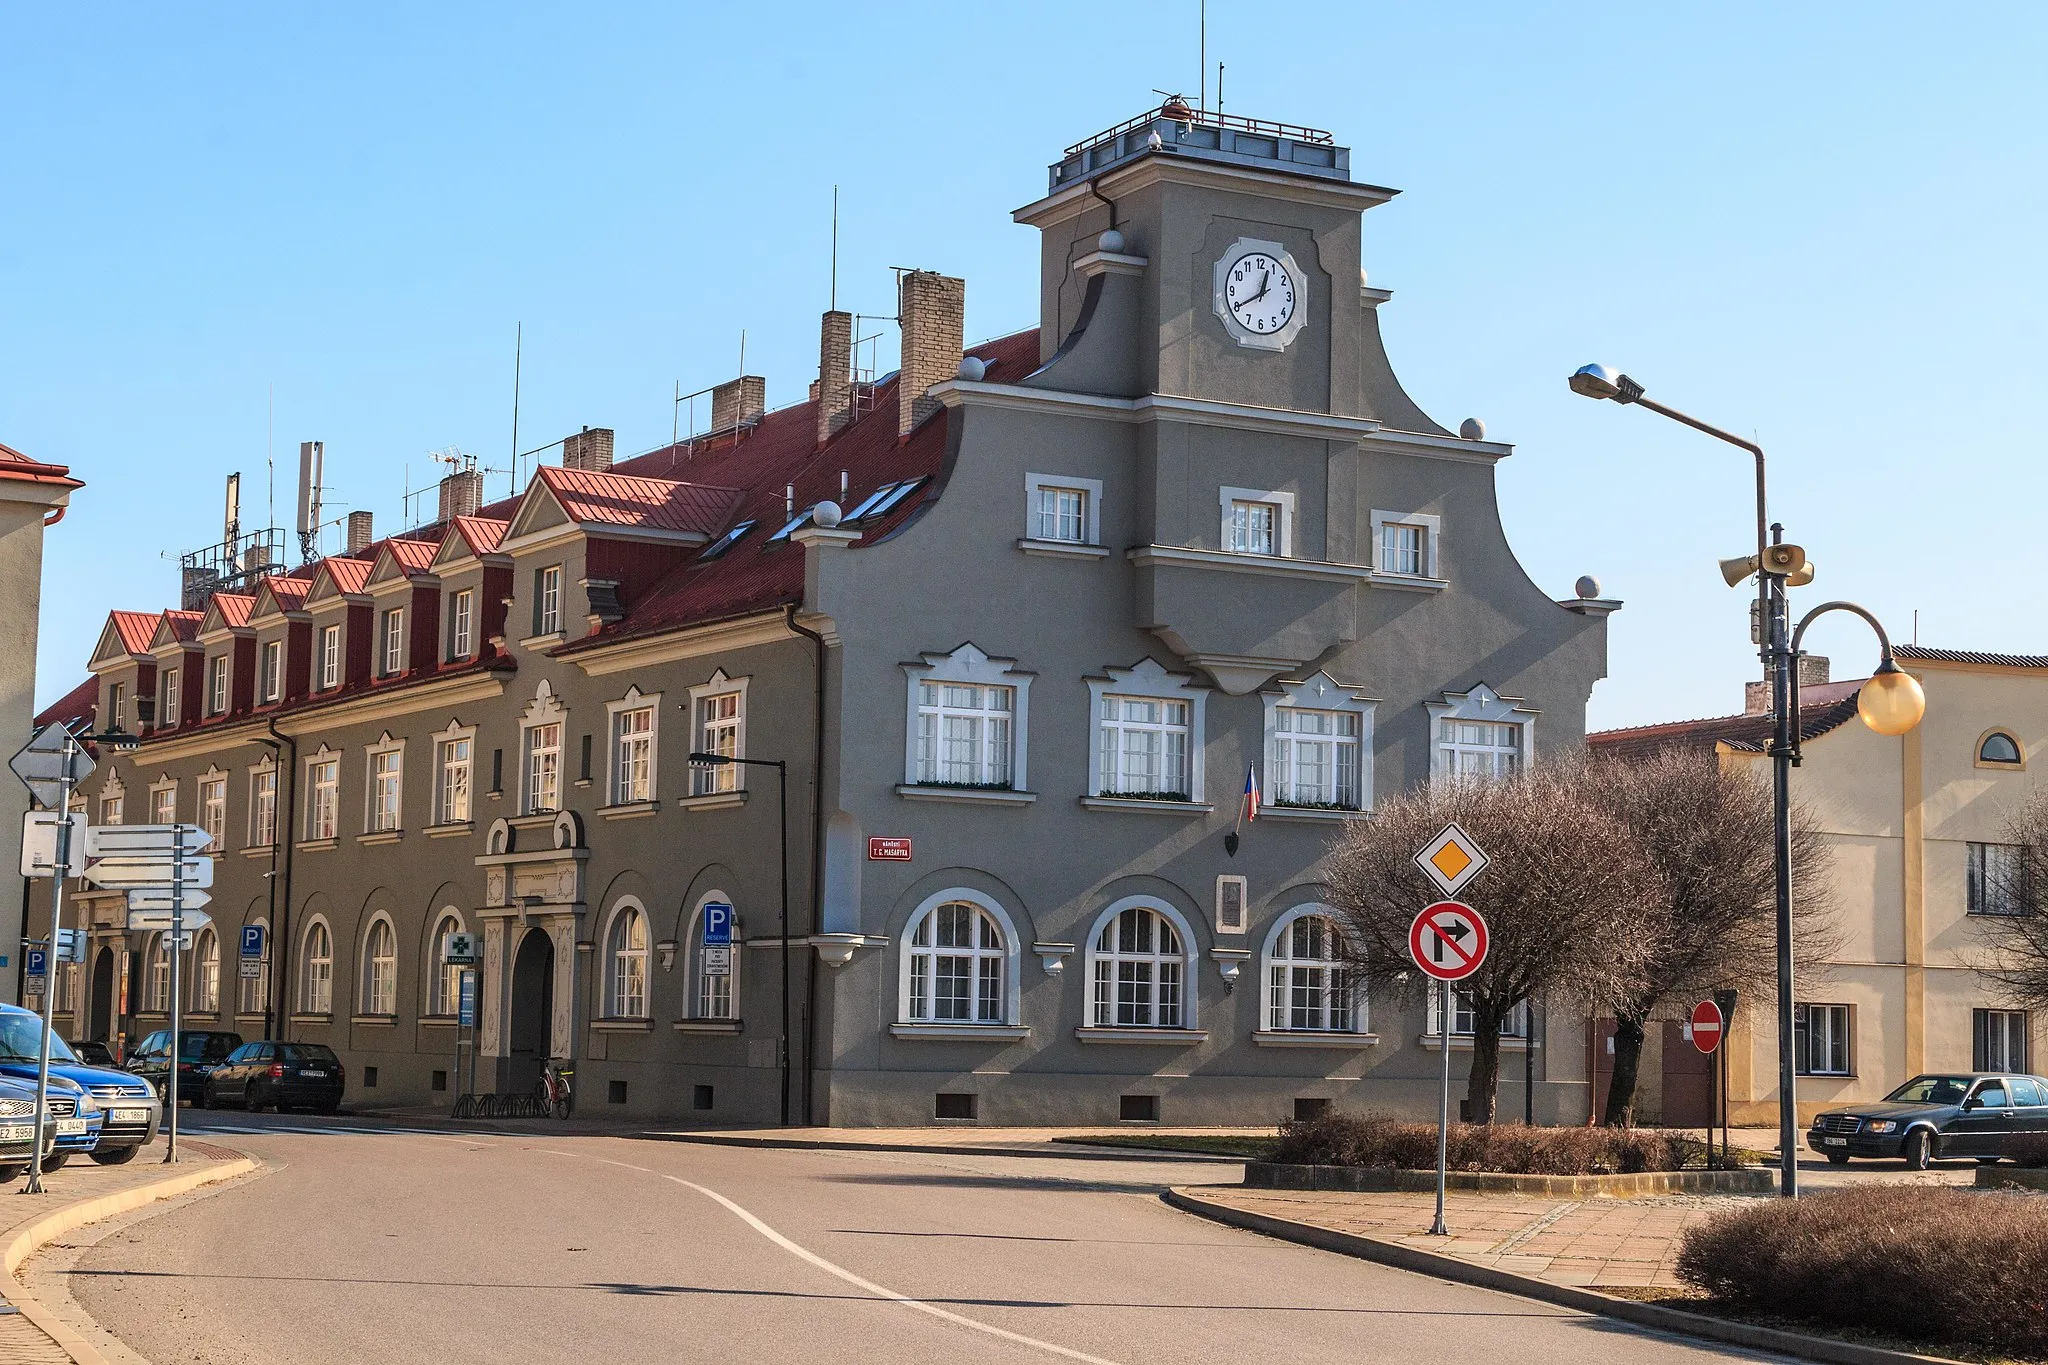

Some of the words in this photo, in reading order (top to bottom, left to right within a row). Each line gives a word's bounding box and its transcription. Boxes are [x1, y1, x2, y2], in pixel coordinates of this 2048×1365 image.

[1244, 261, 1251, 272] 11
[1256, 258, 1265, 270] 12
[1271, 264, 1276, 275] 1
[1234, 270, 1243, 281] 10
[1280, 275, 1287, 286] 2
[1229, 285, 1235, 296] 9
[1286, 291, 1292, 302] 3
[1233, 301, 1240, 312] 8
[1280, 307, 1286, 318] 4
[1246, 313, 1252, 325] 7
[1258, 318, 1264, 330] 6
[1271, 316, 1277, 328] 5
[710, 909, 726, 933] P
[246, 929, 259, 947] P
[31, 953, 43, 968] P
[114, 1110, 126, 1120] 4E4
[0, 1128, 10, 1139] E2
[15, 1127, 33, 1138] 5958
